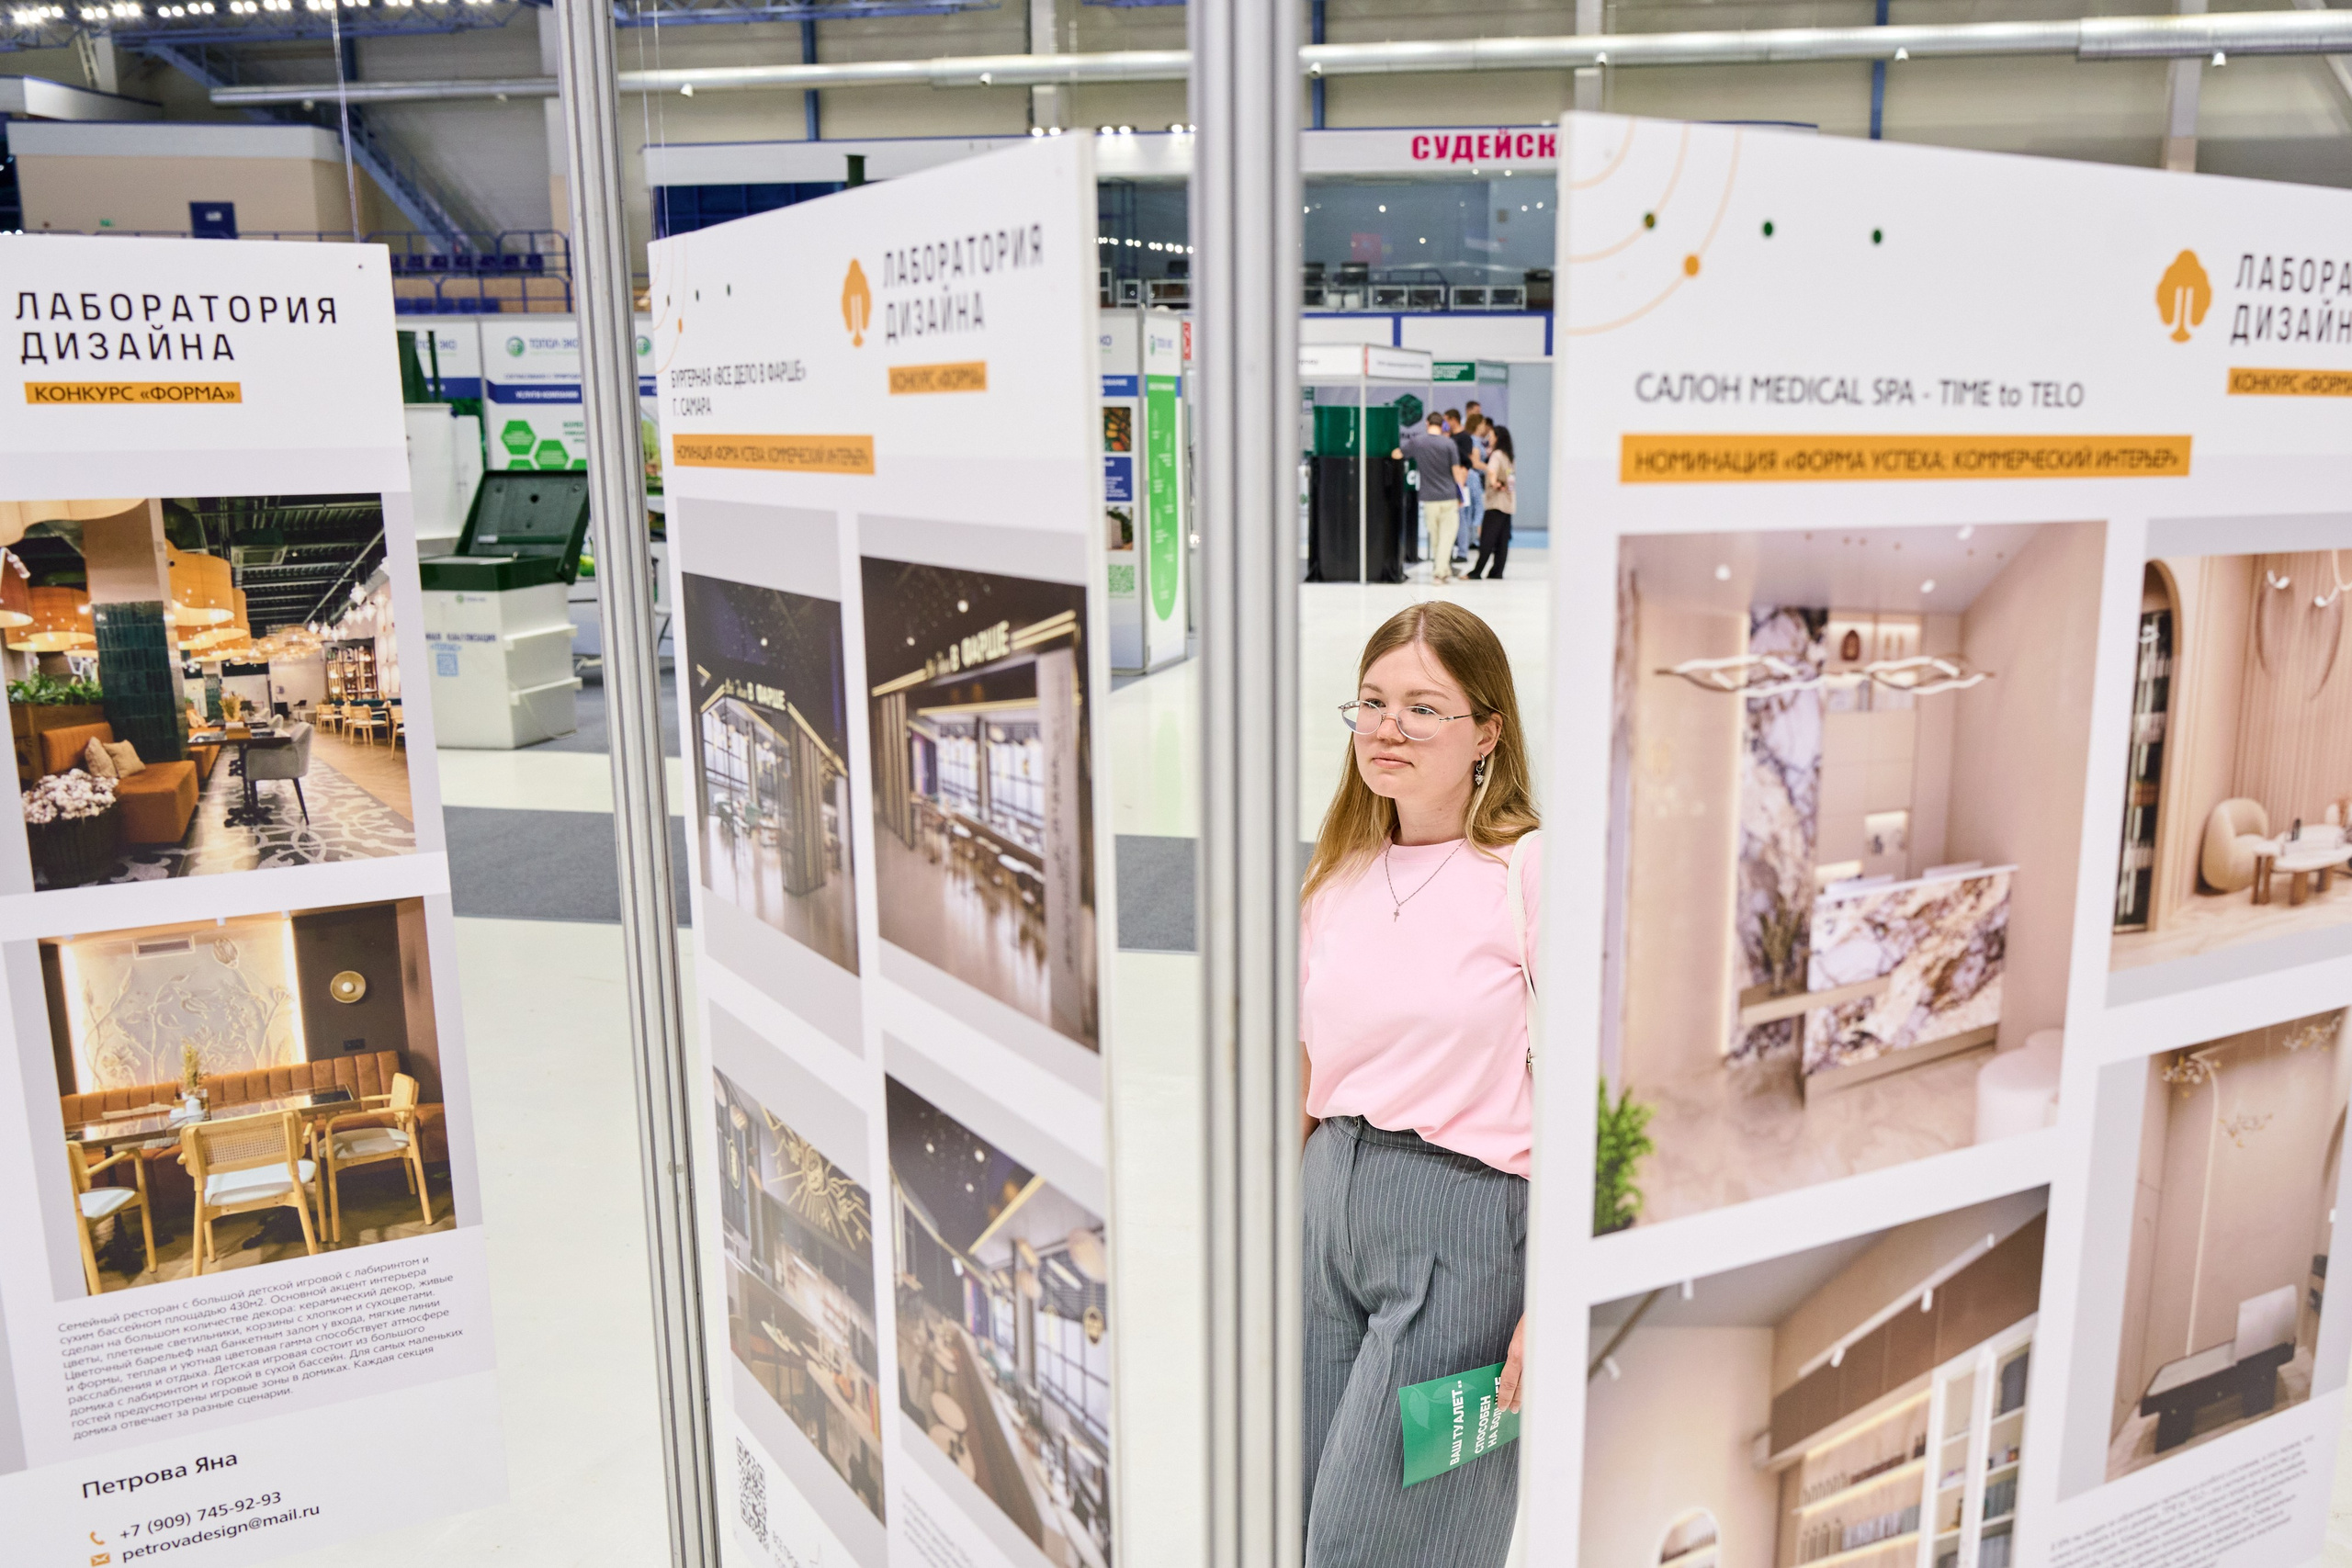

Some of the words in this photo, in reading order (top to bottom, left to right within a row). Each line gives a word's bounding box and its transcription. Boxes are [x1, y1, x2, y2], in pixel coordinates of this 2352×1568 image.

[1412, 128, 1559, 164] СУДЕЙСК
[884, 223, 1043, 288] ЛАБОРАТОРИЯ
[2235, 254, 2352, 296] ЛАБОРА
[16, 292, 337, 323] ЛАБОРАТОРИЯ
[885, 284, 985, 346] ДИЗАЙНА
[21, 324, 235, 365] ДИЗАЙНА
[35, 387, 134, 401] КОНКУРС
[141, 387, 236, 401] «ФОРМА»
[672, 368, 711, 388] БУРГЕРНАЯ
[734, 363, 757, 389] ДЕЛО
[760, 363, 765, 383] В
[1635, 373, 1740, 403] САЛОН
[1751, 377, 1863, 405] MEDICAL
[1872, 378, 1915, 405] SPA
[1939, 378, 1992, 407] TIME
[1999, 382, 2021, 406] to
[2030, 381, 2085, 408] TELO
[681, 397, 712, 415] САМАРА
[1634, 449, 1777, 474] НОМИНАЦИЯ
[1784, 449, 1865, 472] «ФОРМА
[1953, 446, 2091, 470] КОММЕРЧЕСКИЙ
[57, 1313, 120, 1333] Семейный
[122, 1303, 180, 1323] ресторан
[182, 1301, 189, 1310] с
[191, 1289, 245, 1307] большой
[247, 1280, 294, 1299] детской
[296, 1271, 343, 1288] игровой
[345, 1270, 352, 1279] с
[354, 1258, 420, 1277] лабиринтом
[60, 1332, 95, 1346] сухим
[96, 1318, 162, 1337] бассейном
[164, 1306, 227, 1325] площадью
[270, 1285, 327, 1304] Основной
[330, 1280, 368, 1293] акцент
[369, 1268, 427, 1285] интерьера
[61, 1342, 105, 1358] сделан
[107, 1338, 122, 1348] на
[124, 1327, 181, 1345] большом
[183, 1314, 249, 1333] количестве
[251, 1305, 296, 1322] декора:
[299, 1288, 377, 1311] керамический
[379, 1282, 416, 1297] декор,
[418, 1274, 454, 1288] живые
[62, 1355, 103, 1370] цветы,
[106, 1342, 164, 1360] плетеные
[166, 1327, 243, 1348] светильники,
[245, 1316, 295, 1333] корзины
[297, 1314, 303, 1323] с
[306, 1305, 353, 1321] хлопком
[356, 1303, 363, 1312] и
[365, 1290, 435, 1310] сухоцветами.
[64, 1359, 132, 1382] Цветочный
[135, 1348, 195, 1367] барельеф
[197, 1344, 219, 1354] над
[220, 1331, 283, 1349] банкетным
[286, 1324, 320, 1337] залом
[322, 1322, 328, 1331] у
[331, 1314, 366, 1328] входа,
[368, 1306, 406, 1320] мягкие
[408, 1300, 440, 1313] линии
[66, 1384, 74, 1393] и
[76, 1375, 123, 1392] формы,
[126, 1366, 167, 1380] теплая
[179, 1355, 221, 1371] уютная
[224, 1344, 277, 1361] цветовая
[279, 1337, 312, 1349] гамма
[314, 1321, 389, 1342] способствует
[390, 1309, 449, 1327] атмосфере
[67, 1381, 153, 1406] расслабления
[164, 1370, 210, 1384] отдыха.
[213, 1359, 260, 1376] Детская
[262, 1348, 308, 1365] игровая
[310, 1339, 353, 1355] состоит
[356, 1337, 368, 1346] из
[370, 1325, 425, 1343] большого
[70, 1401, 115, 1418] домика
[117, 1398, 124, 1406] с
[127, 1383, 198, 1404] лабиринтом
[211, 1371, 253, 1387] горкой
[265, 1361, 297, 1376] сухой
[299, 1353, 346, 1369] бассейн.
[348, 1348, 370, 1360] Для
[373, 1340, 406, 1354] самых
[408, 1329, 464, 1347] маленьких
[71, 1412, 111, 1428] гостей
[114, 1393, 208, 1419] предусмотрены
[209, 1382, 258, 1399] игровые
[261, 1376, 289, 1389] зоны
[292, 1374, 300, 1382] в
[301, 1364, 350, 1382] домиках.
[353, 1354, 395, 1369] Каждая
[397, 1346, 435, 1360] секция
[73, 1424, 118, 1441] домика
[120, 1412, 174, 1430] отвечает
[176, 1409, 189, 1418] за
[192, 1399, 234, 1416] разные
[237, 1387, 293, 1405] сценарии.
[1475, 1395, 1491, 1454] СПОСОБЕН
[1487, 1429, 1498, 1449] НА
[82, 1465, 187, 1499] Петрова
[196, 1454, 238, 1473] Яна
[1450, 1439, 1462, 1465] ВАШ
[120, 1524, 140, 1540] +7
[148, 1512, 191, 1535] (909)
[198, 1492, 281, 1521] 745-92-93
[122, 1505, 320, 1562] petrovadesign@mail.ru
